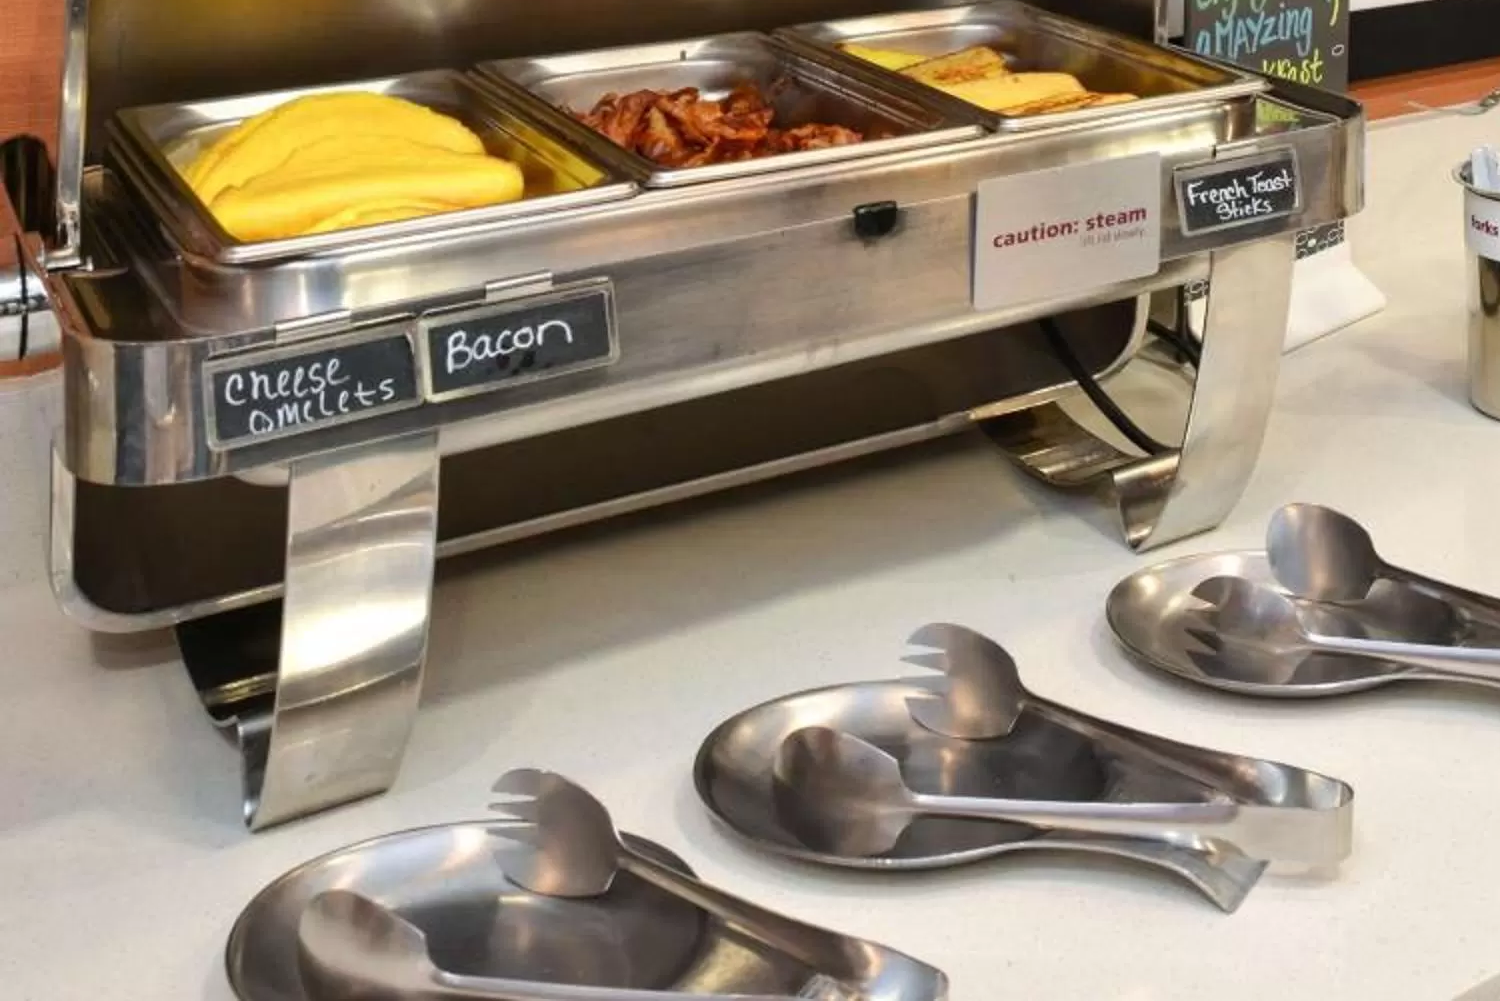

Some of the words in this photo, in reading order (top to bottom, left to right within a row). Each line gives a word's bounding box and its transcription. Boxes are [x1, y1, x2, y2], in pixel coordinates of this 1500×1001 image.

[1187, 179, 1249, 206] French
[1246, 169, 1293, 194] Toast
[993, 218, 1079, 249] caution:
[1086, 207, 1147, 232] steam
[1216, 198, 1273, 221] Sticks
[447, 320, 573, 375] Bacon
